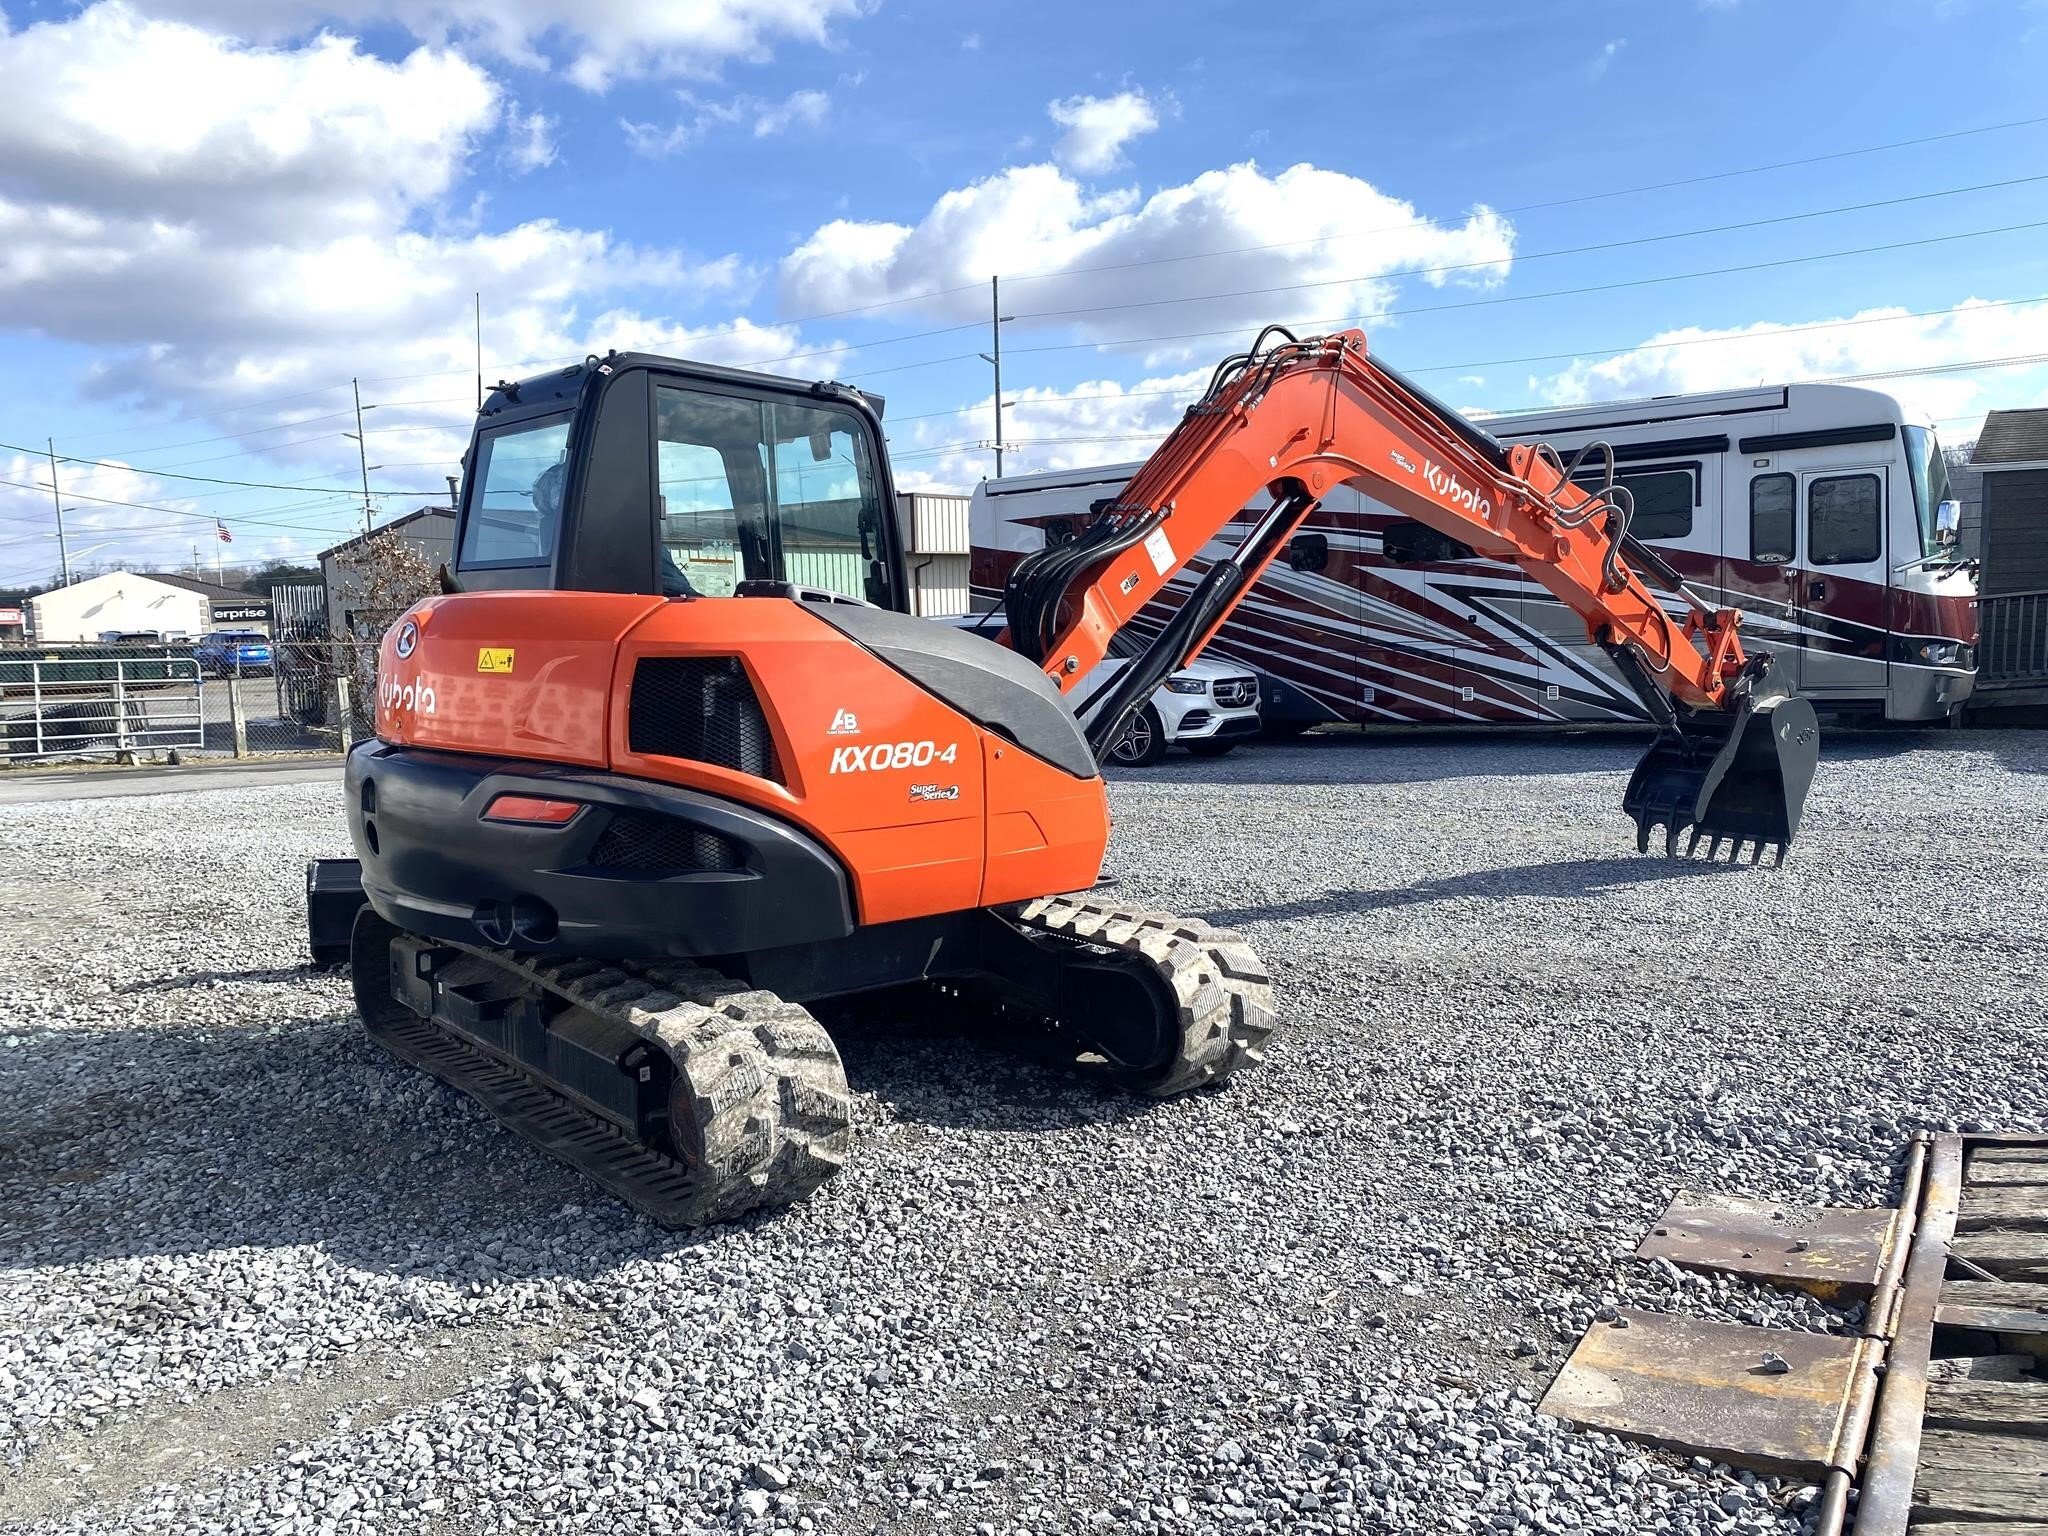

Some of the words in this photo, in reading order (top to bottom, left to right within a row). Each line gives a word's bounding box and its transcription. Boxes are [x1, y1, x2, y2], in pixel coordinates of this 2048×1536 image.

[1423, 459, 1491, 520] Kubota
[214, 608, 267, 620] erprise
[380, 673, 436, 714] Kubota
[830, 708, 857, 731] AB
[829, 740, 958, 774] KX080-4
[910, 784, 938, 796] Super
